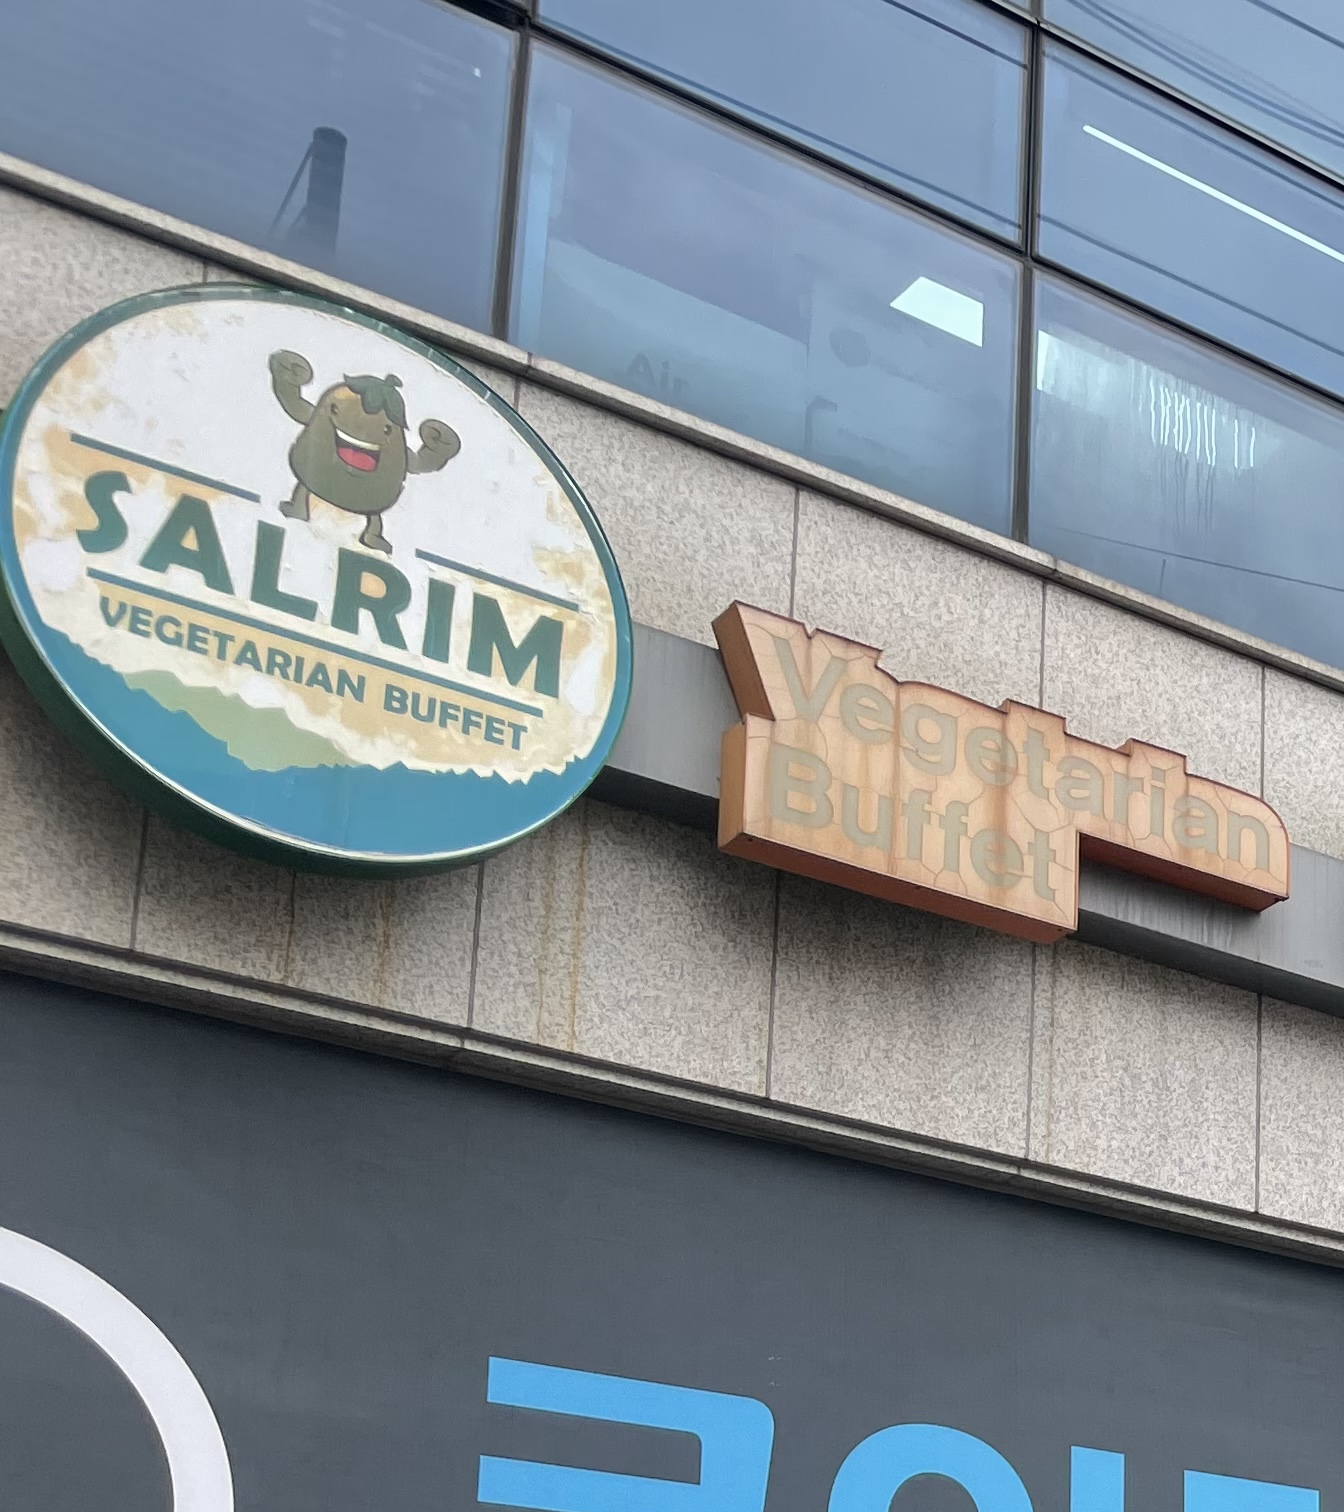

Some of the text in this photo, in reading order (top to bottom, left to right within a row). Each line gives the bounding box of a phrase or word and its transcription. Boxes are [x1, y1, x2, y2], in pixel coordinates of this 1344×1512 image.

[75, 470, 564, 698] SALRIM
[100, 594, 527, 750] VEGETARIAN BUFFET
[767, 742, 1057, 900] Buffet
[774, 637, 1270, 871] Vegetarian
